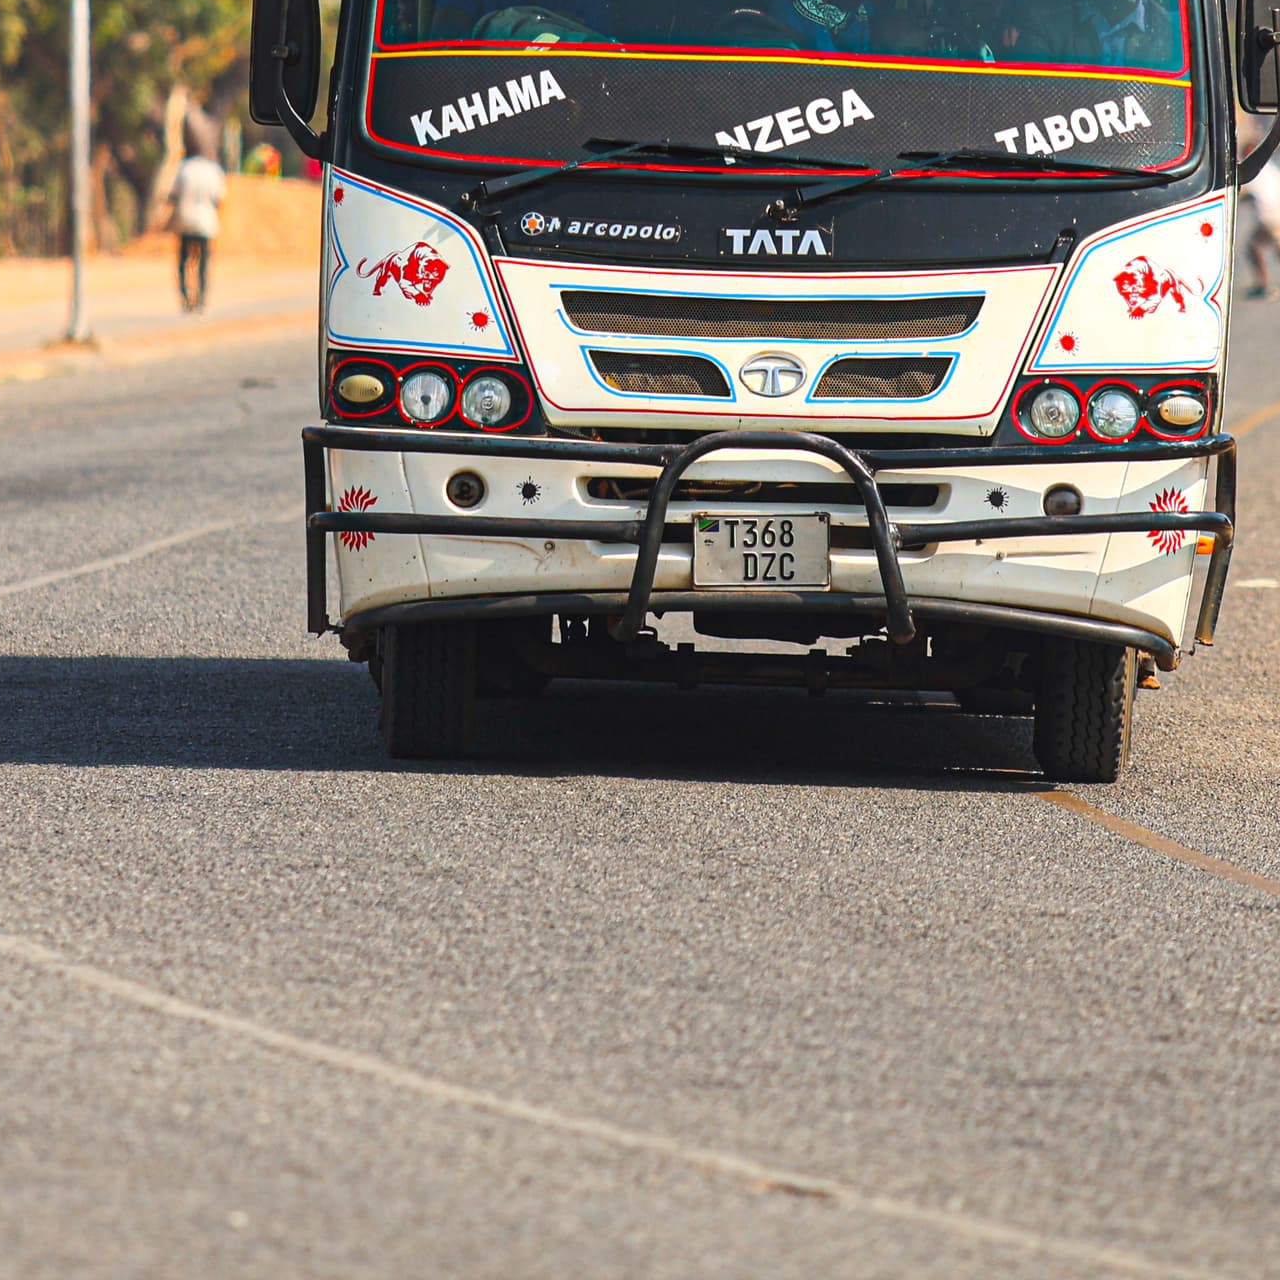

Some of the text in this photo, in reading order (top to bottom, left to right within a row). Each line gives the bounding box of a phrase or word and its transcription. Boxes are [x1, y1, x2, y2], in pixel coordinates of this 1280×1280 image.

[409, 69, 567, 147] KAHAMA
[714, 88, 876, 165] NZEGA
[994, 95, 1152, 156] TABORA
[725, 228, 827, 256] TATA
[724, 519, 795, 549] T368
[743, 552, 796, 582] DZC
